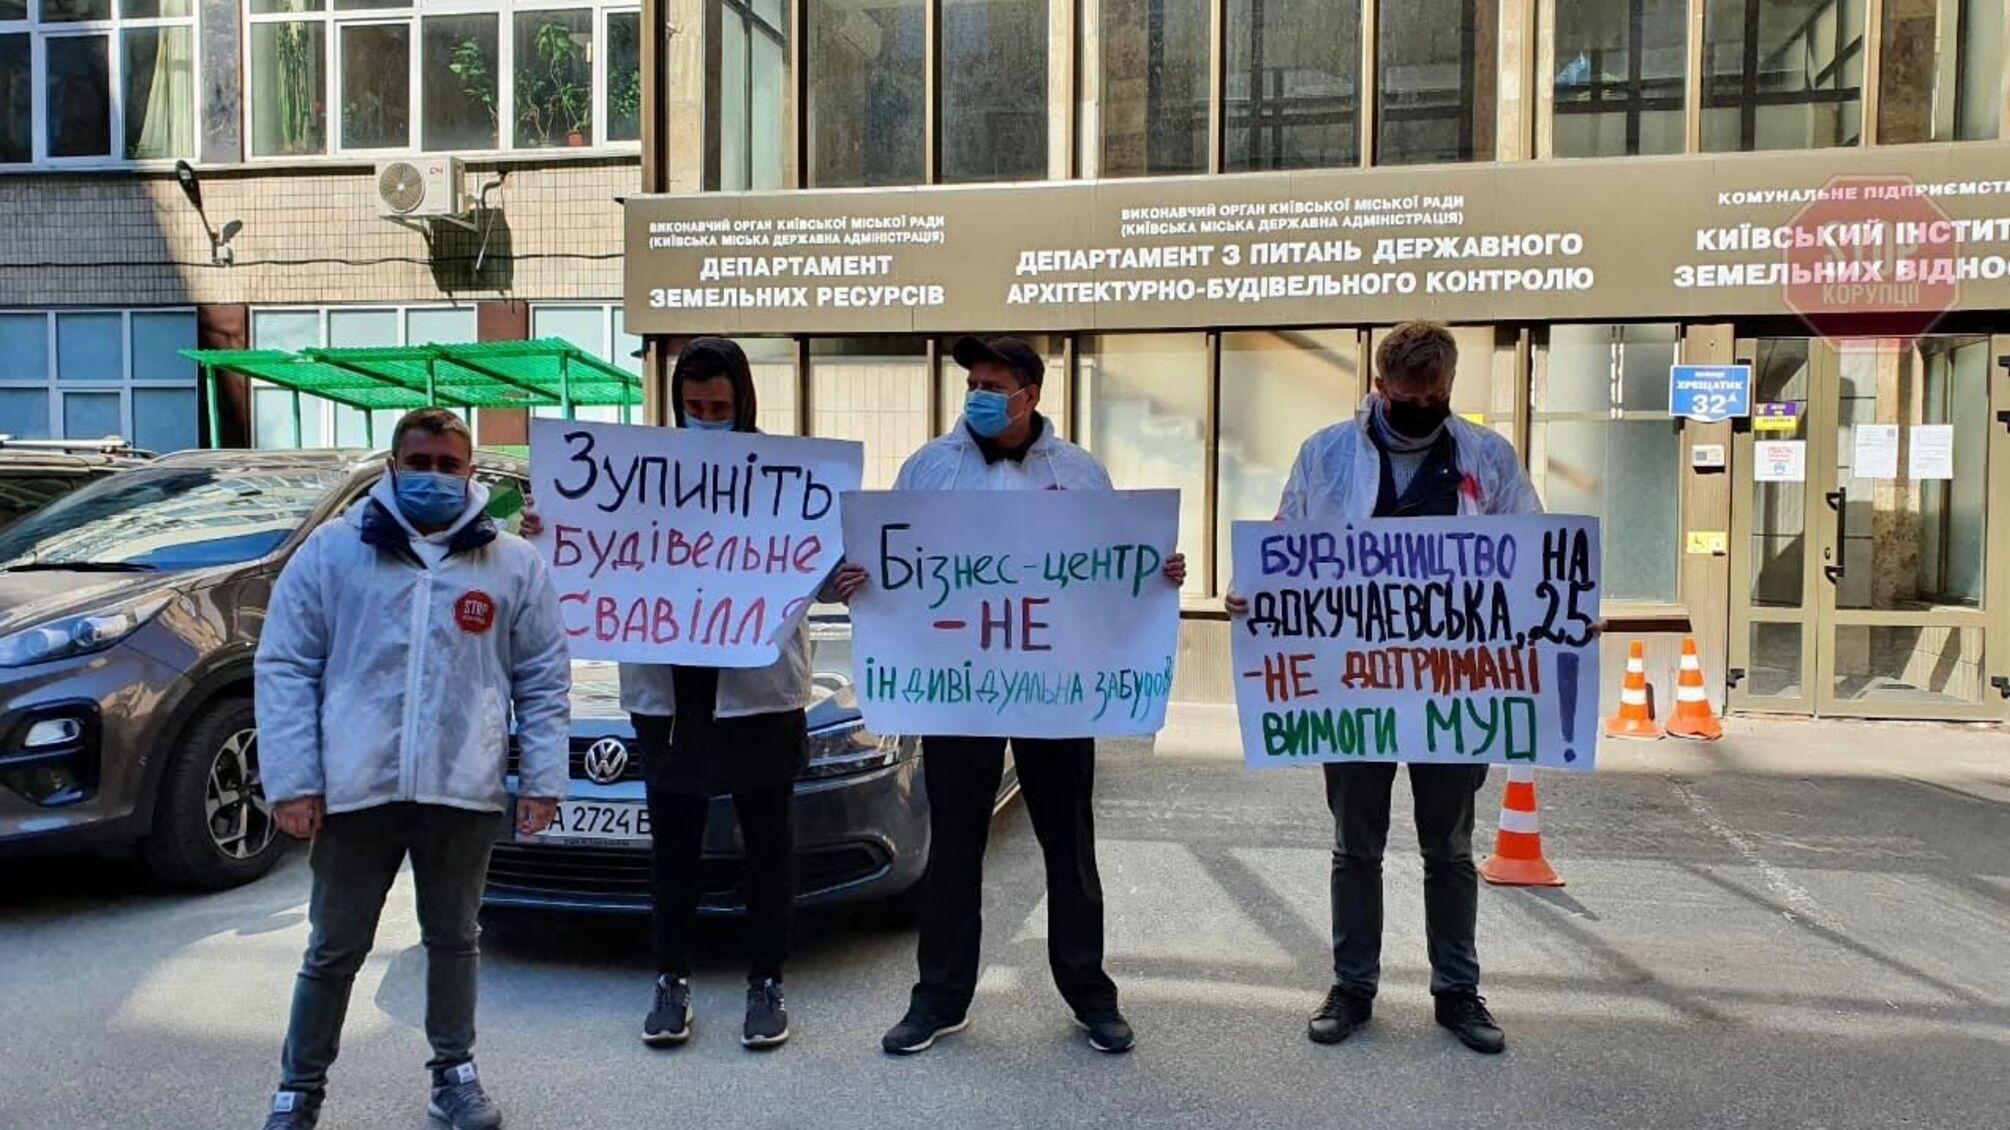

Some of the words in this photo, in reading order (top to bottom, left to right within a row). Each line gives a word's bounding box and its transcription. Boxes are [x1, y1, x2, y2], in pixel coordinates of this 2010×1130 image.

[1718, 187, 1857, 205] КОМУНАЛЬНЕ
[1864, 181, 2010, 200] ПІДПРИЄМСТ
[1121, 204, 1216, 221] ВИКОНАВЧИЙ
[1219, 203, 1266, 217] ОРГАН
[1269, 199, 1350, 215] КИЇВСЬКОЇ
[1354, 195, 1418, 211] МІСЬКОЇ
[1423, 195, 1465, 209] РАДИ
[649, 218, 731, 233] ВИКОНАВЧИЙ
[733, 219, 772, 232] ОРГАН
[777, 216, 848, 231] КИЇВСЬКОЇ
[851, 214, 906, 229] МІСЬКОЇ
[909, 215, 945, 229] РАДИ
[1121, 221, 1197, 238] (КИЇВСЬКА
[1200, 219, 1255, 233] МІСЬКА
[1257, 216, 1339, 233] ДЕРЖАВНА
[1342, 212, 1465, 229] АДМІНІСТРАЦІЯ)
[1696, 218, 1884, 251] КИЇВСЬКИЙ
[649, 234, 718, 250] (КИЇВСЬКА
[721, 234, 769, 247] МІСЬКА
[772, 233, 841, 248] ДЕРЖАВНА
[843, 230, 945, 246] АДМІНІСТРАЦІЯ)
[1015, 244, 1214, 276] ДЕПАРТАМЕНТ
[1221, 243, 1241, 266] З
[1250, 239, 1362, 265] ПИТАНЬ
[1372, 232, 1584, 265] ДЕРЖАВНОГО
[700, 255, 893, 281] ДЕПАРТАМЕНТ
[1673, 258, 1884, 288] ЗЕМЕЛЬНИХ
[1895, 254, 2010, 286] ВІДНО
[649, 287, 808, 308] ЗЕМЕЛЬНИХ
[816, 285, 945, 307] РЕСУРСІВ
[1006, 272, 1417, 304] АРХІТЕКТУРНО-БУДІВЕЛЬНОГО
[1425, 266, 1595, 294] КОНТРОЛЮ
[1260, 523, 1517, 585] БУДІВНИЦТВО
[1542, 526, 1591, 583] НА
[1341, 640, 1541, 695] ДОТРИМАНІ
[1261, 704, 1400, 757] ВИМОГИ
[572, 806, 630, 835] 2724
